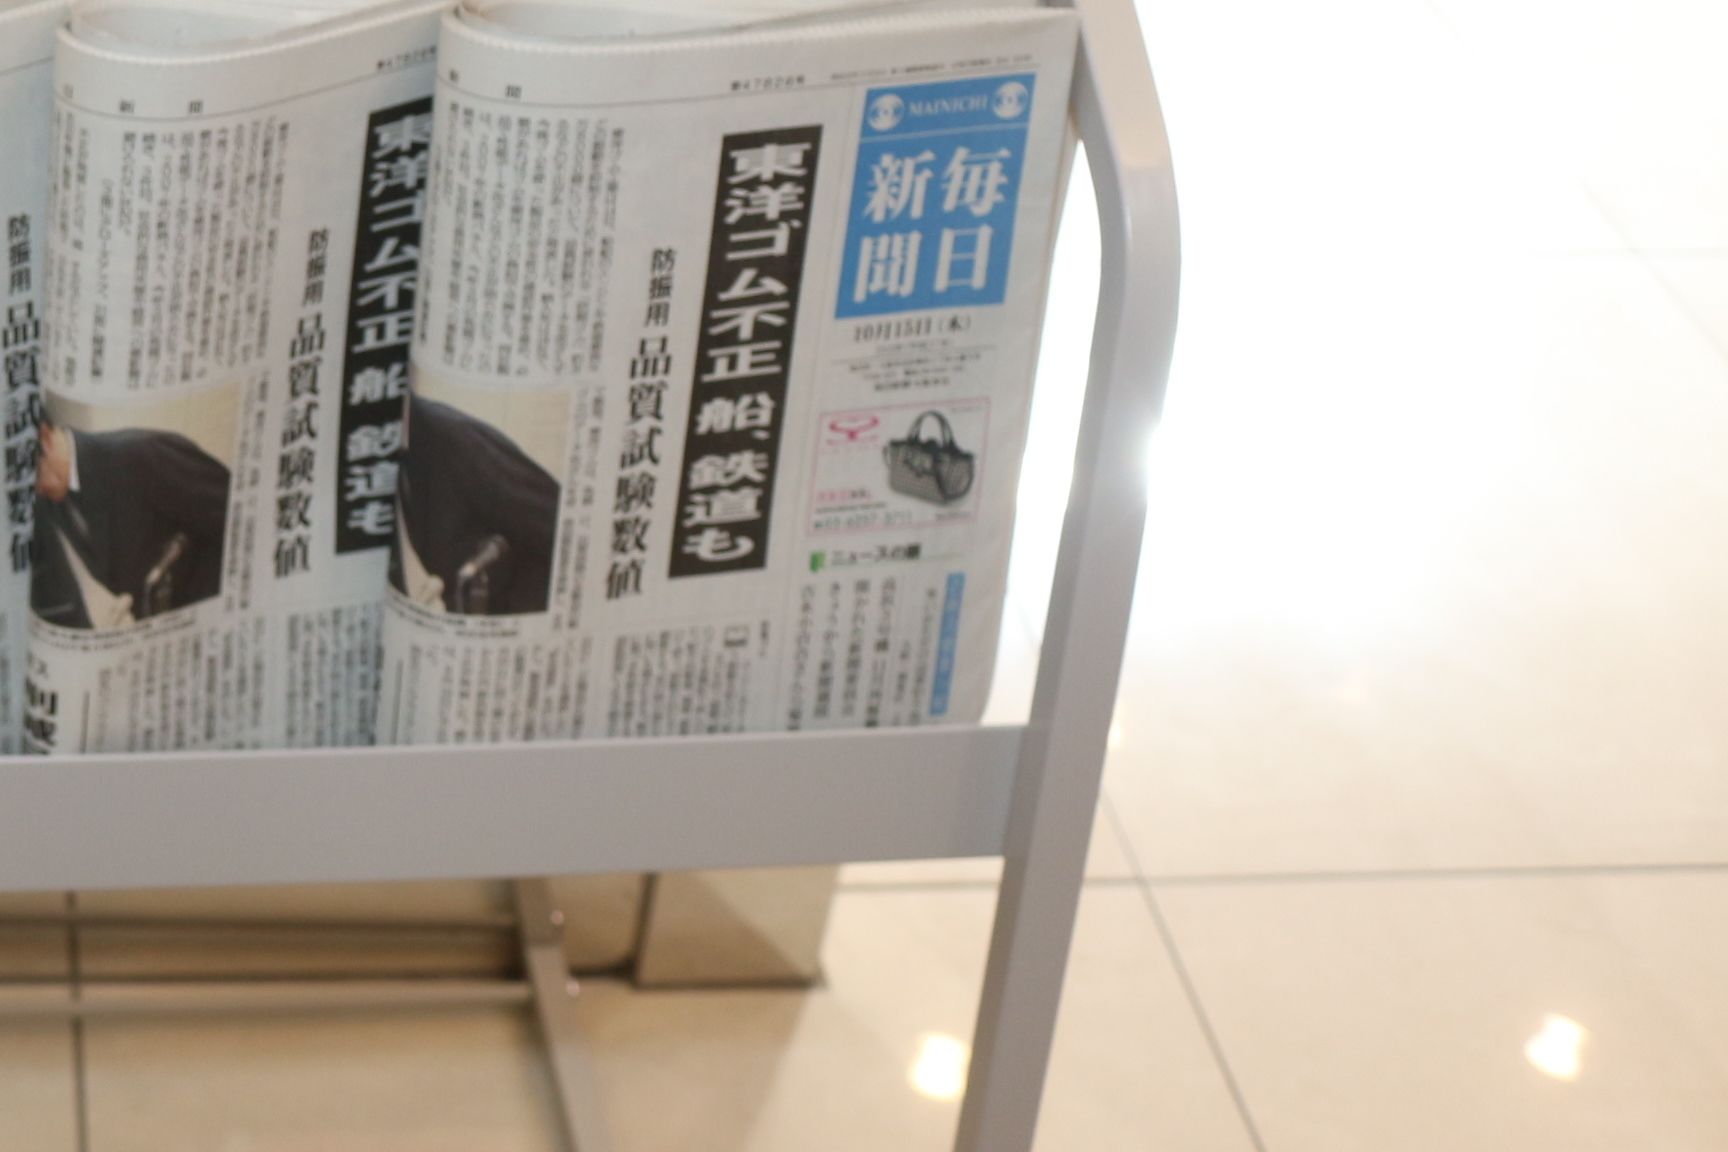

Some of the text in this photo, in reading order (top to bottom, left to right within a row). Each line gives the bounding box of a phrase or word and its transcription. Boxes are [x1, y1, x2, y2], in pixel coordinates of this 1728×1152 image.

[908, 95, 988, 117] MAINICHI
[853, 150, 937, 303] 新聞
[933, 147, 1012, 292] 毎日
[275, 313, 327, 578] 品質試験数値
[680, 141, 811, 563] 東洋ゴム不正 船、鉄道も
[605, 336, 672, 601] 品質試験数値
